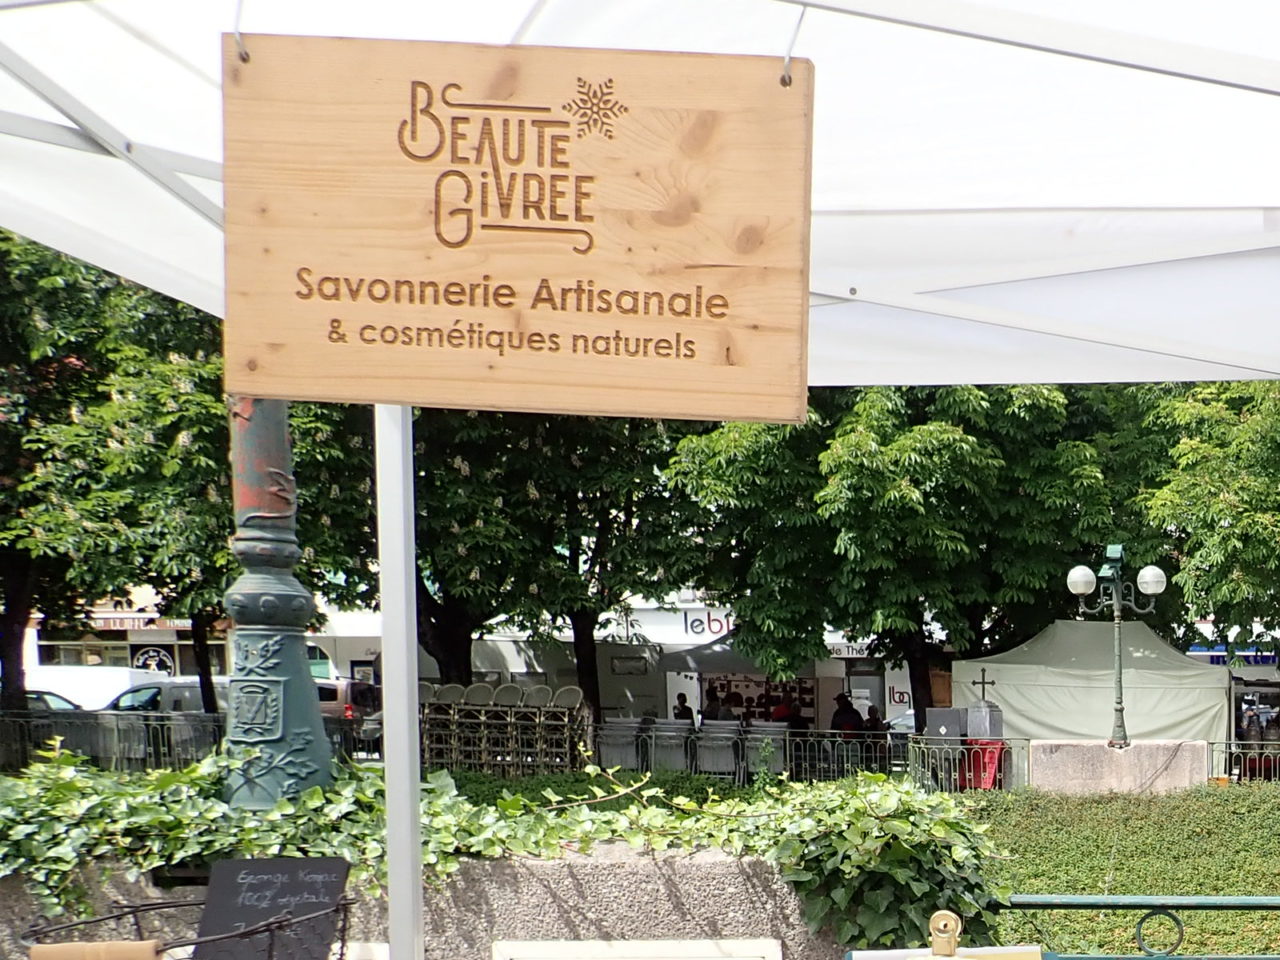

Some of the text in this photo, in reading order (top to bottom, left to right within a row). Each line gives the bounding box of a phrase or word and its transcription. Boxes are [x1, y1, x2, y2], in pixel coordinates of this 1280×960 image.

[296, 267, 730, 319] Savonnerie Artisanale
[328, 318, 696, 359] & cosmétiques naturels
[845, 646, 865, 656] Thé
